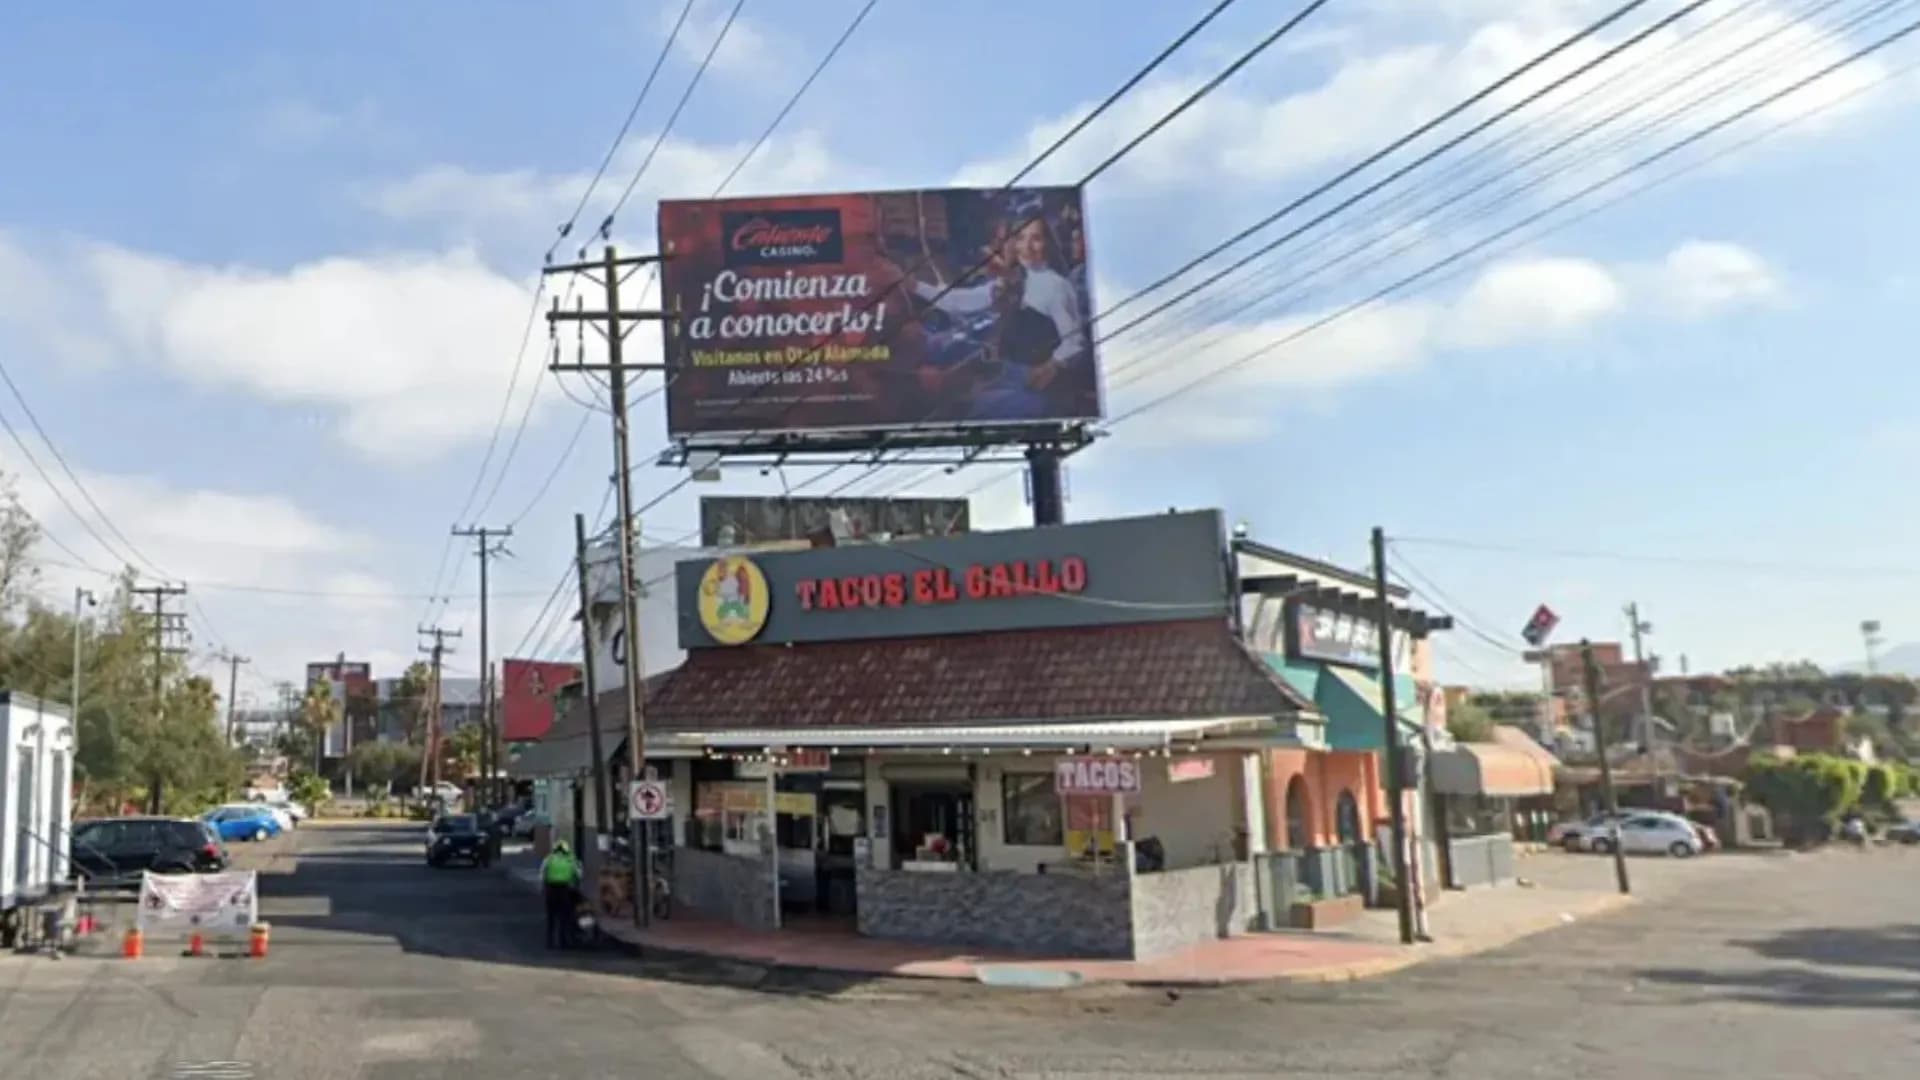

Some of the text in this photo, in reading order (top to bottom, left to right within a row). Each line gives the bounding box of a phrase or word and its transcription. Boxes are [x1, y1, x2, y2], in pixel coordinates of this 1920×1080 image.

[700, 270, 870, 312] ¡Comienza
[689, 316, 716, 340] a
[765, 349, 782, 364] en
[805, 369, 824, 384] 24
[796, 556, 1088, 611] TACOS EL GALLO
[1057, 761, 1136, 789] TACOS
